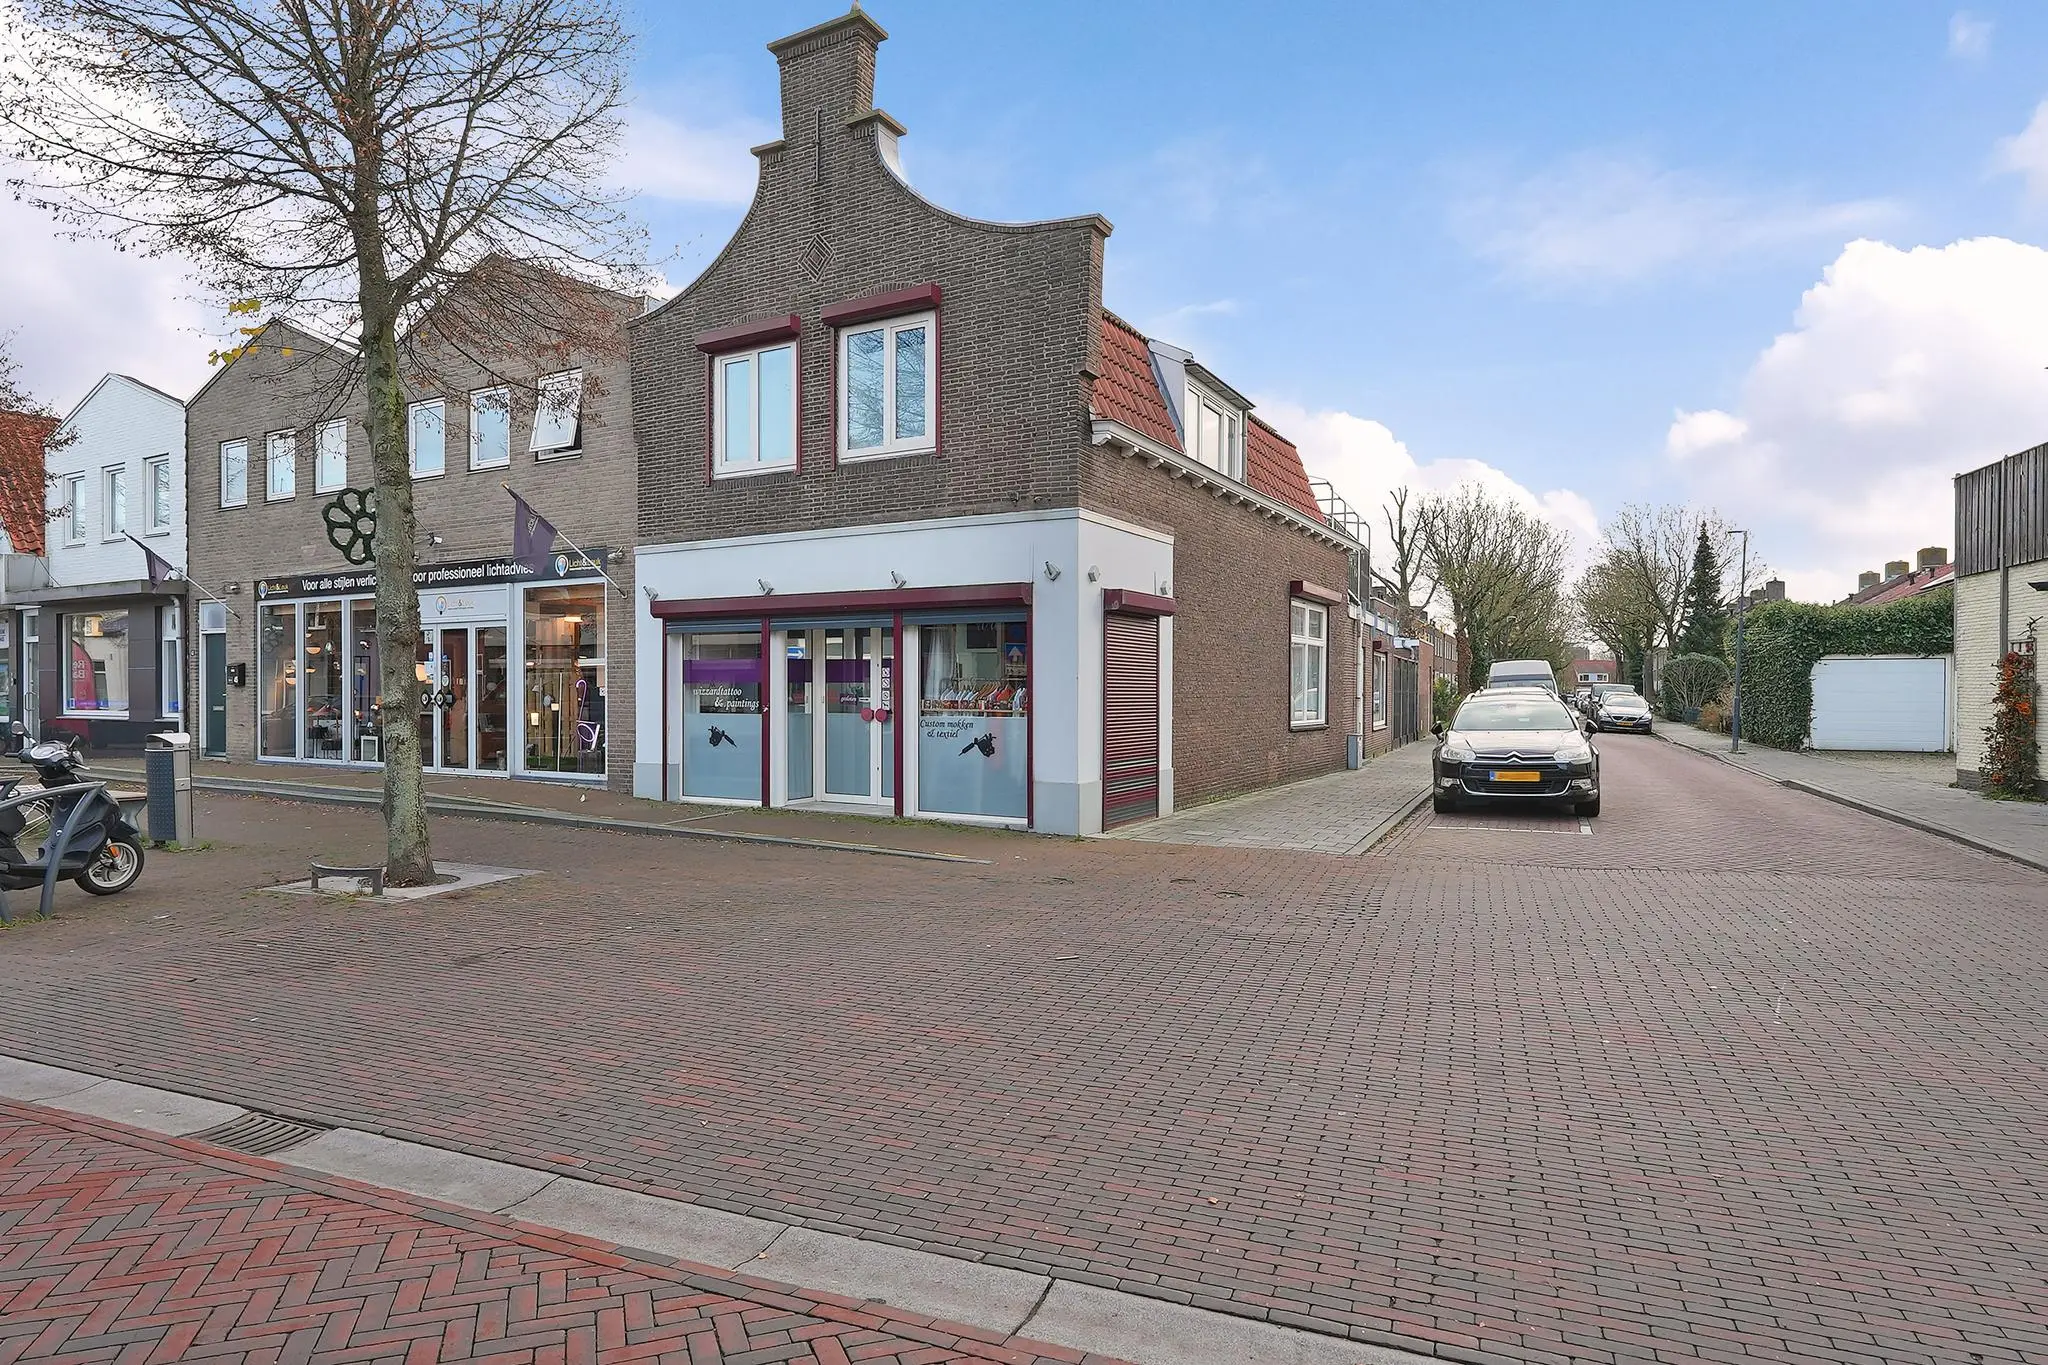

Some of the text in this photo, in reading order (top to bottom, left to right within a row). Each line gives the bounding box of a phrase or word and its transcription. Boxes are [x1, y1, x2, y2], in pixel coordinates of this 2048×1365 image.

[301, 579, 319, 591] Voor
[320, 578, 333, 590] alle
[333, 576, 355, 591] stijlen
[356, 574, 377, 588] verlic
[412, 572, 426, 582] oor
[428, 565, 485, 584] professioneel
[714, 697, 760, 711] & paintings
[920, 719, 974, 730] Custom mokken
[937, 729, 960, 739] textiel
